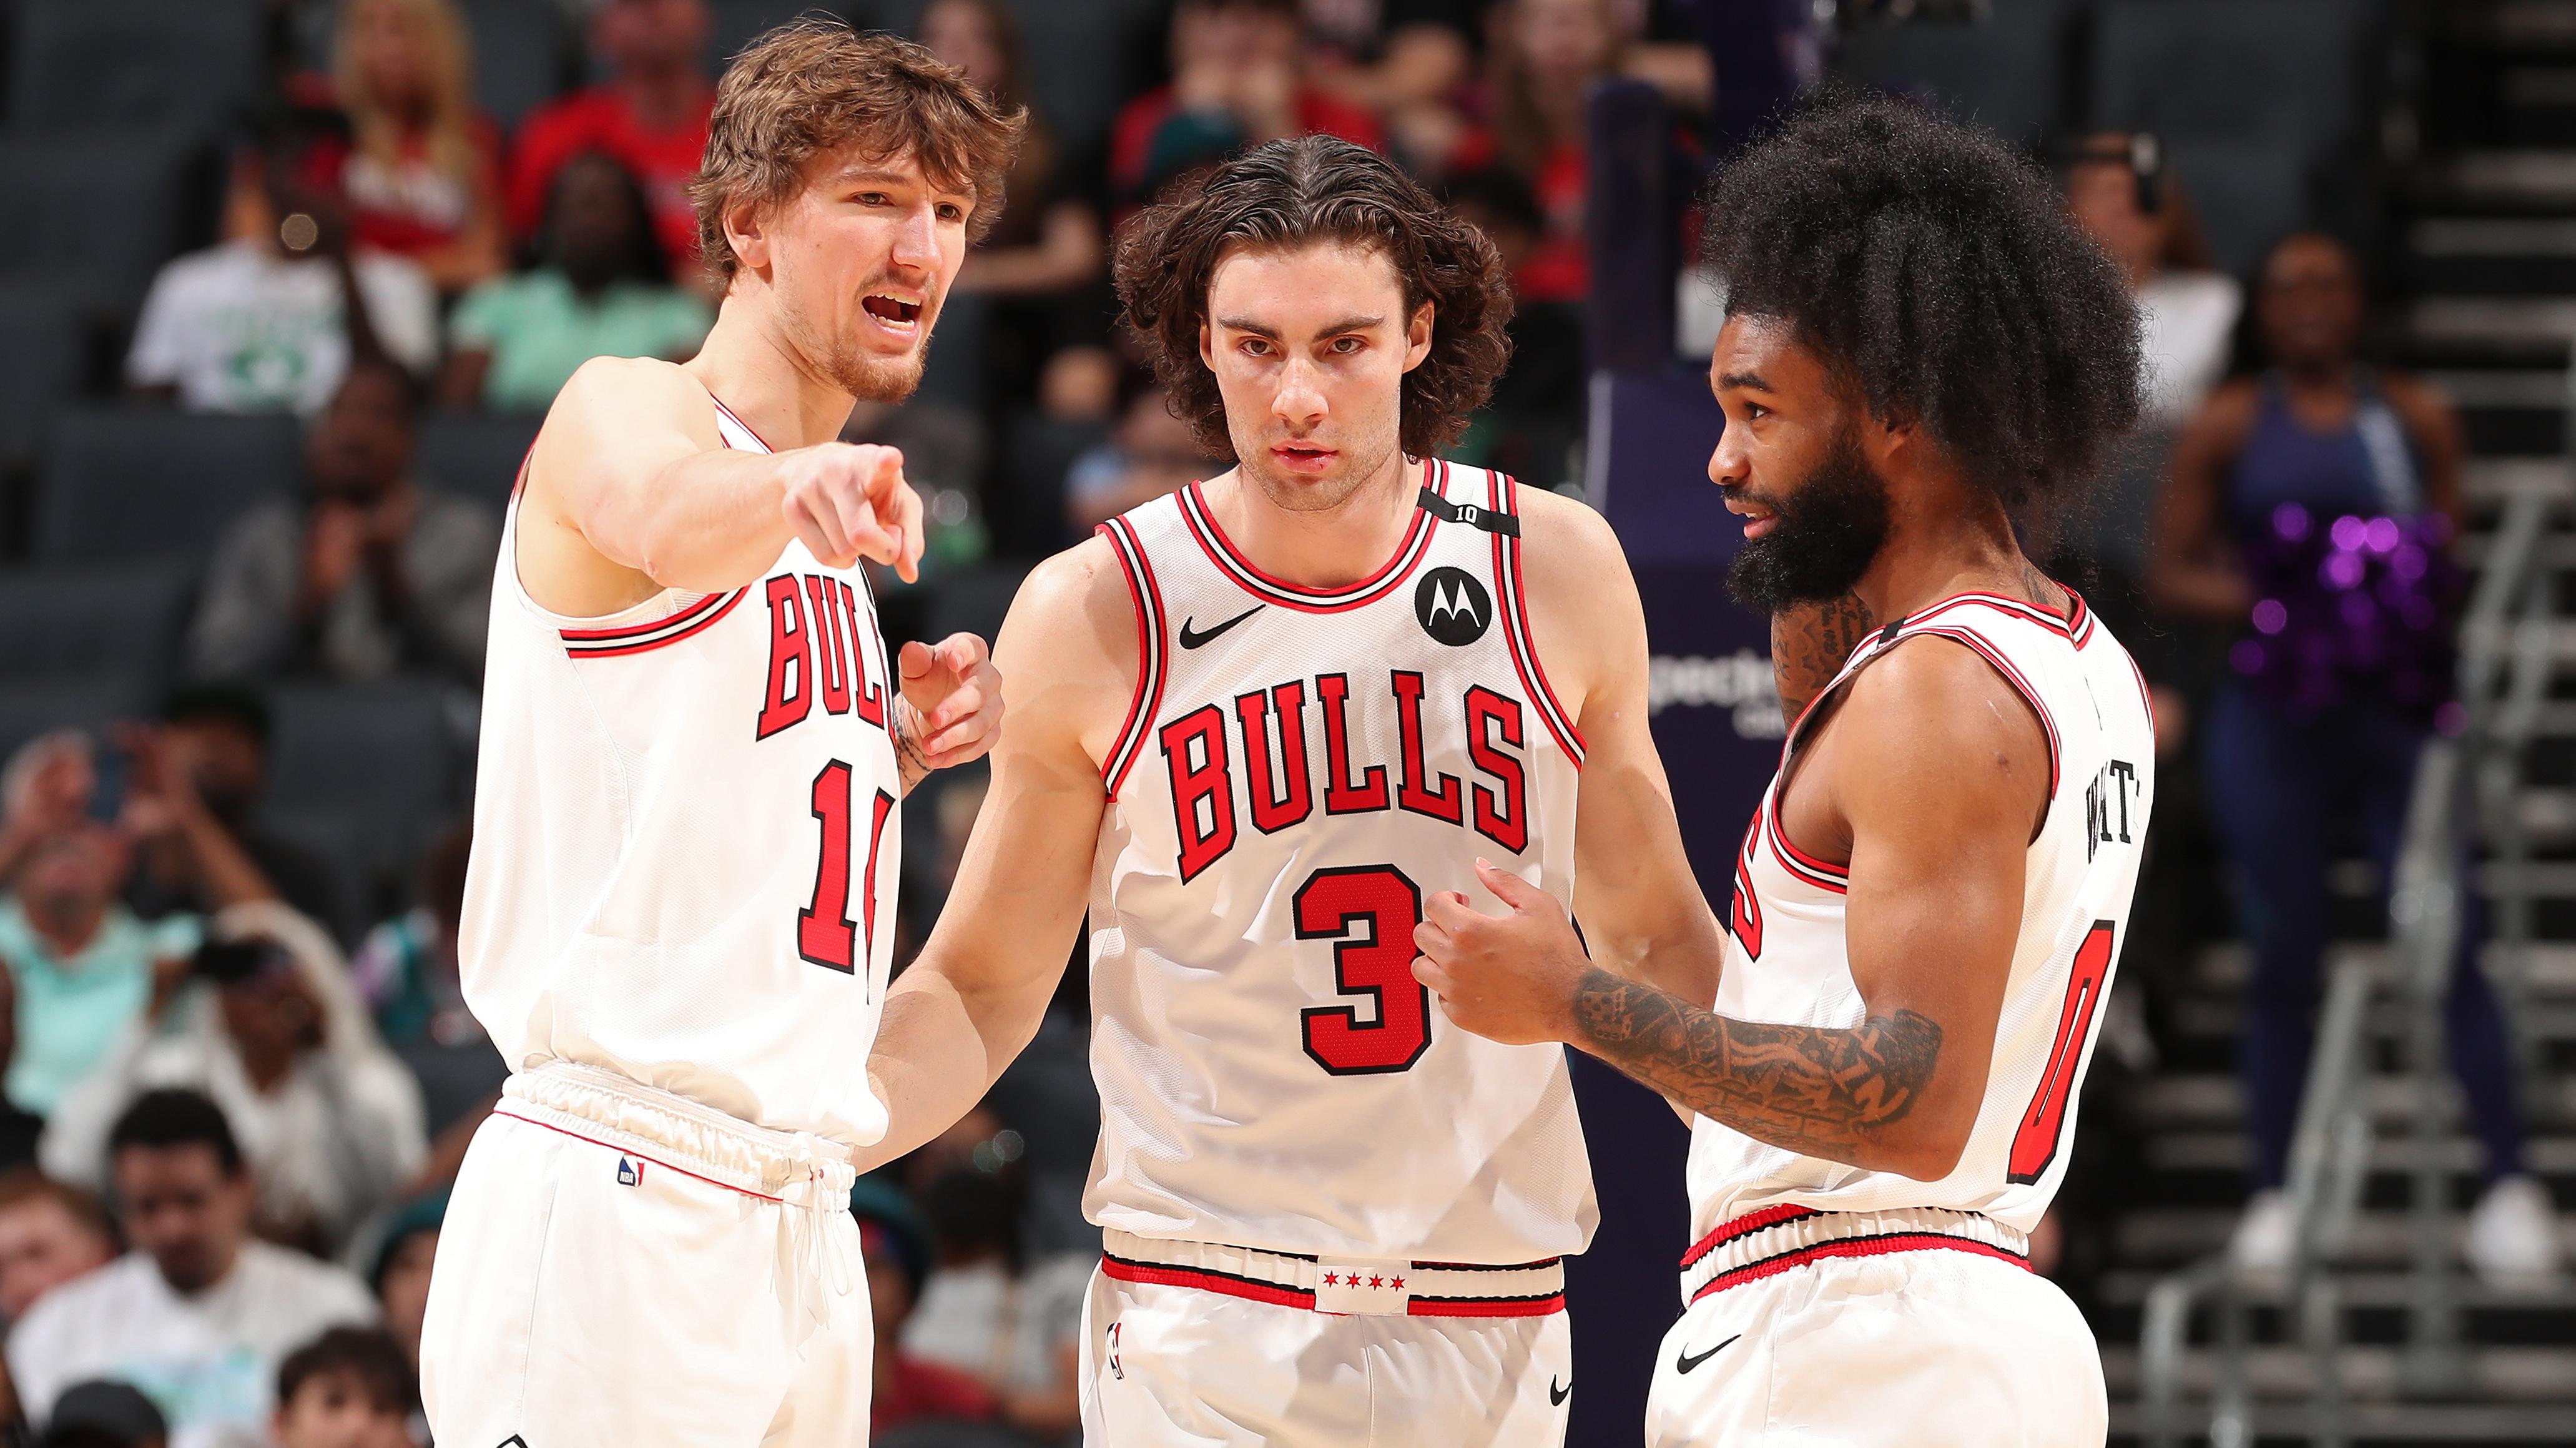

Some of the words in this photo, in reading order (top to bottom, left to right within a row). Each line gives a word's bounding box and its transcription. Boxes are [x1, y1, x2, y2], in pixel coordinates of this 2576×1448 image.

[1455, 506, 1478, 524] 10
[756, 573, 897, 749] BUL
[1159, 669, 1528, 885] BULLS
[1292, 864, 1432, 1076] 3
[2007, 920, 2115, 1186] 0
[619, 1171, 634, 1184] NBA
